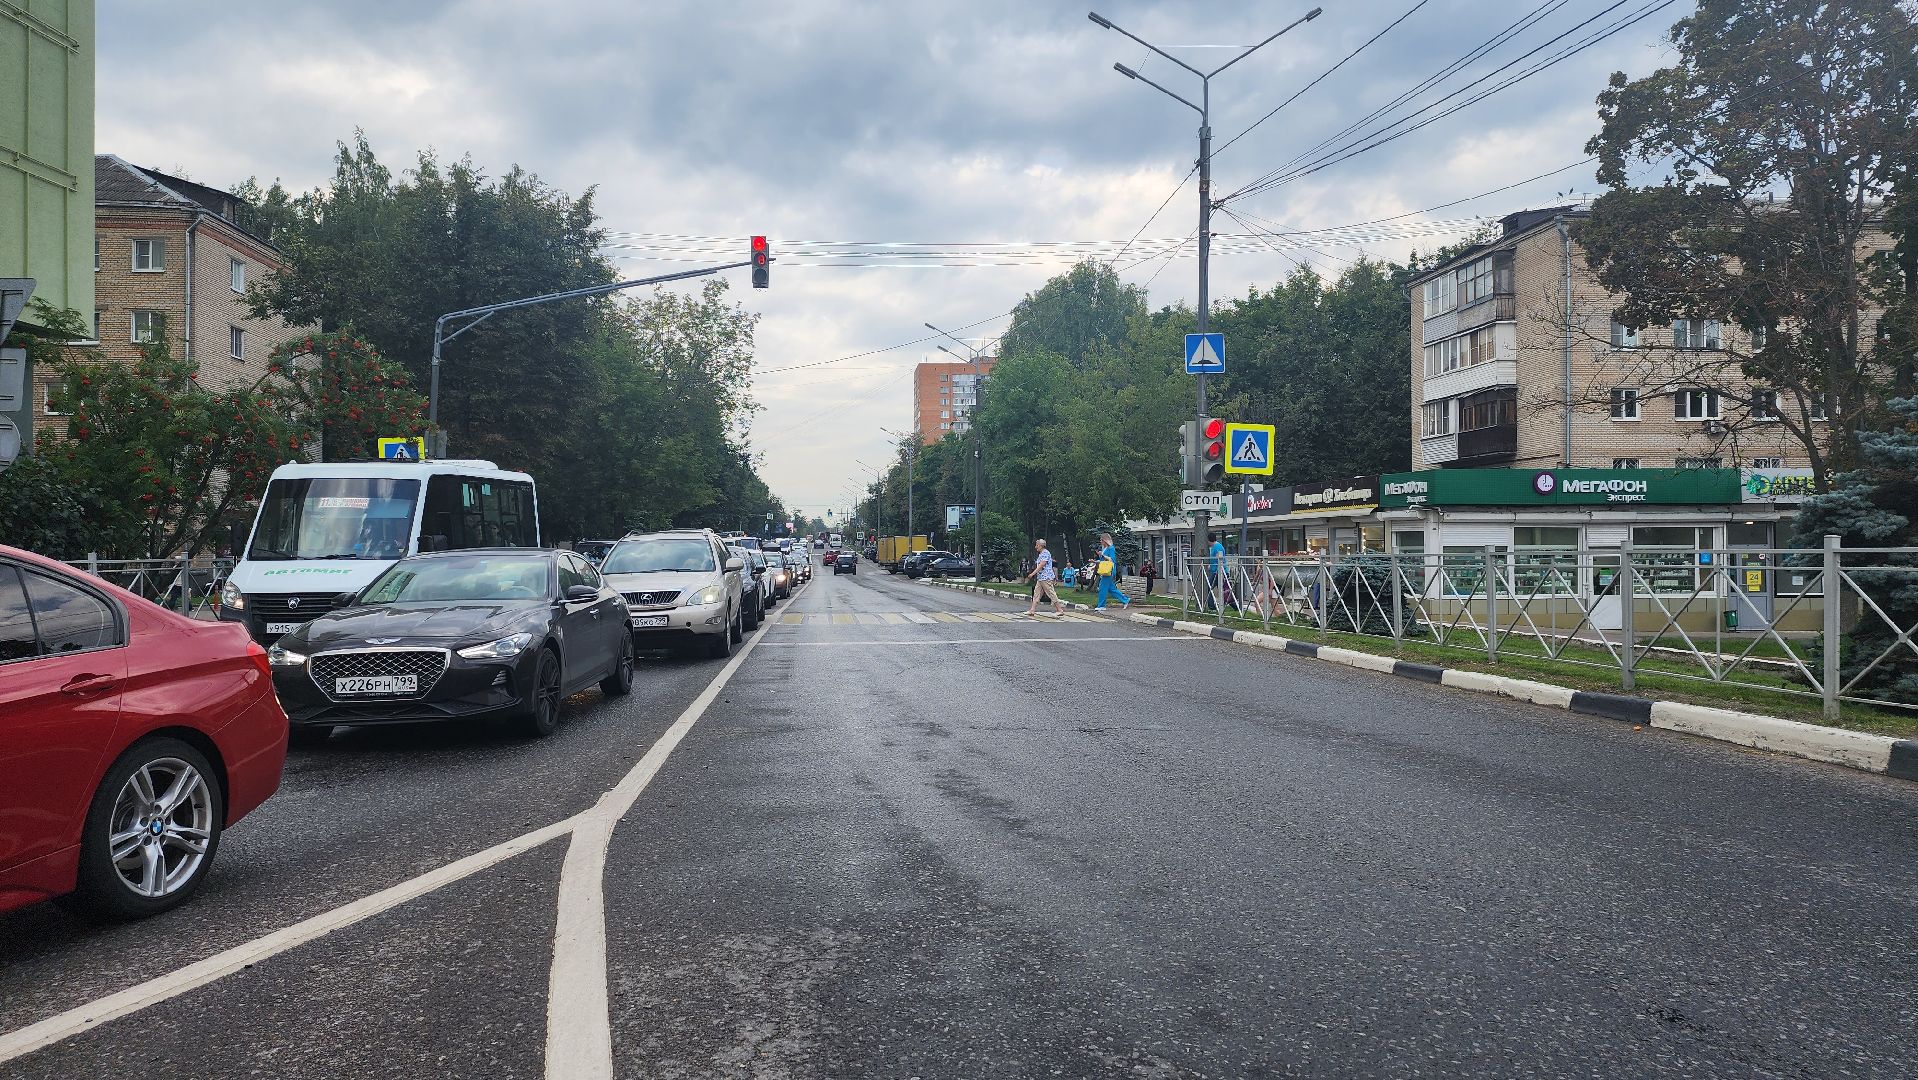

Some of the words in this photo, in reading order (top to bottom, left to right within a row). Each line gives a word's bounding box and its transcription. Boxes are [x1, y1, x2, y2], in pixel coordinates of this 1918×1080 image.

[1562, 479, 1647, 493] МЕГАФОН
[1184, 495, 1220, 505] СТОП
[1606, 493, 1646, 503] Экспресс
[393, 676, 413, 687] 799
